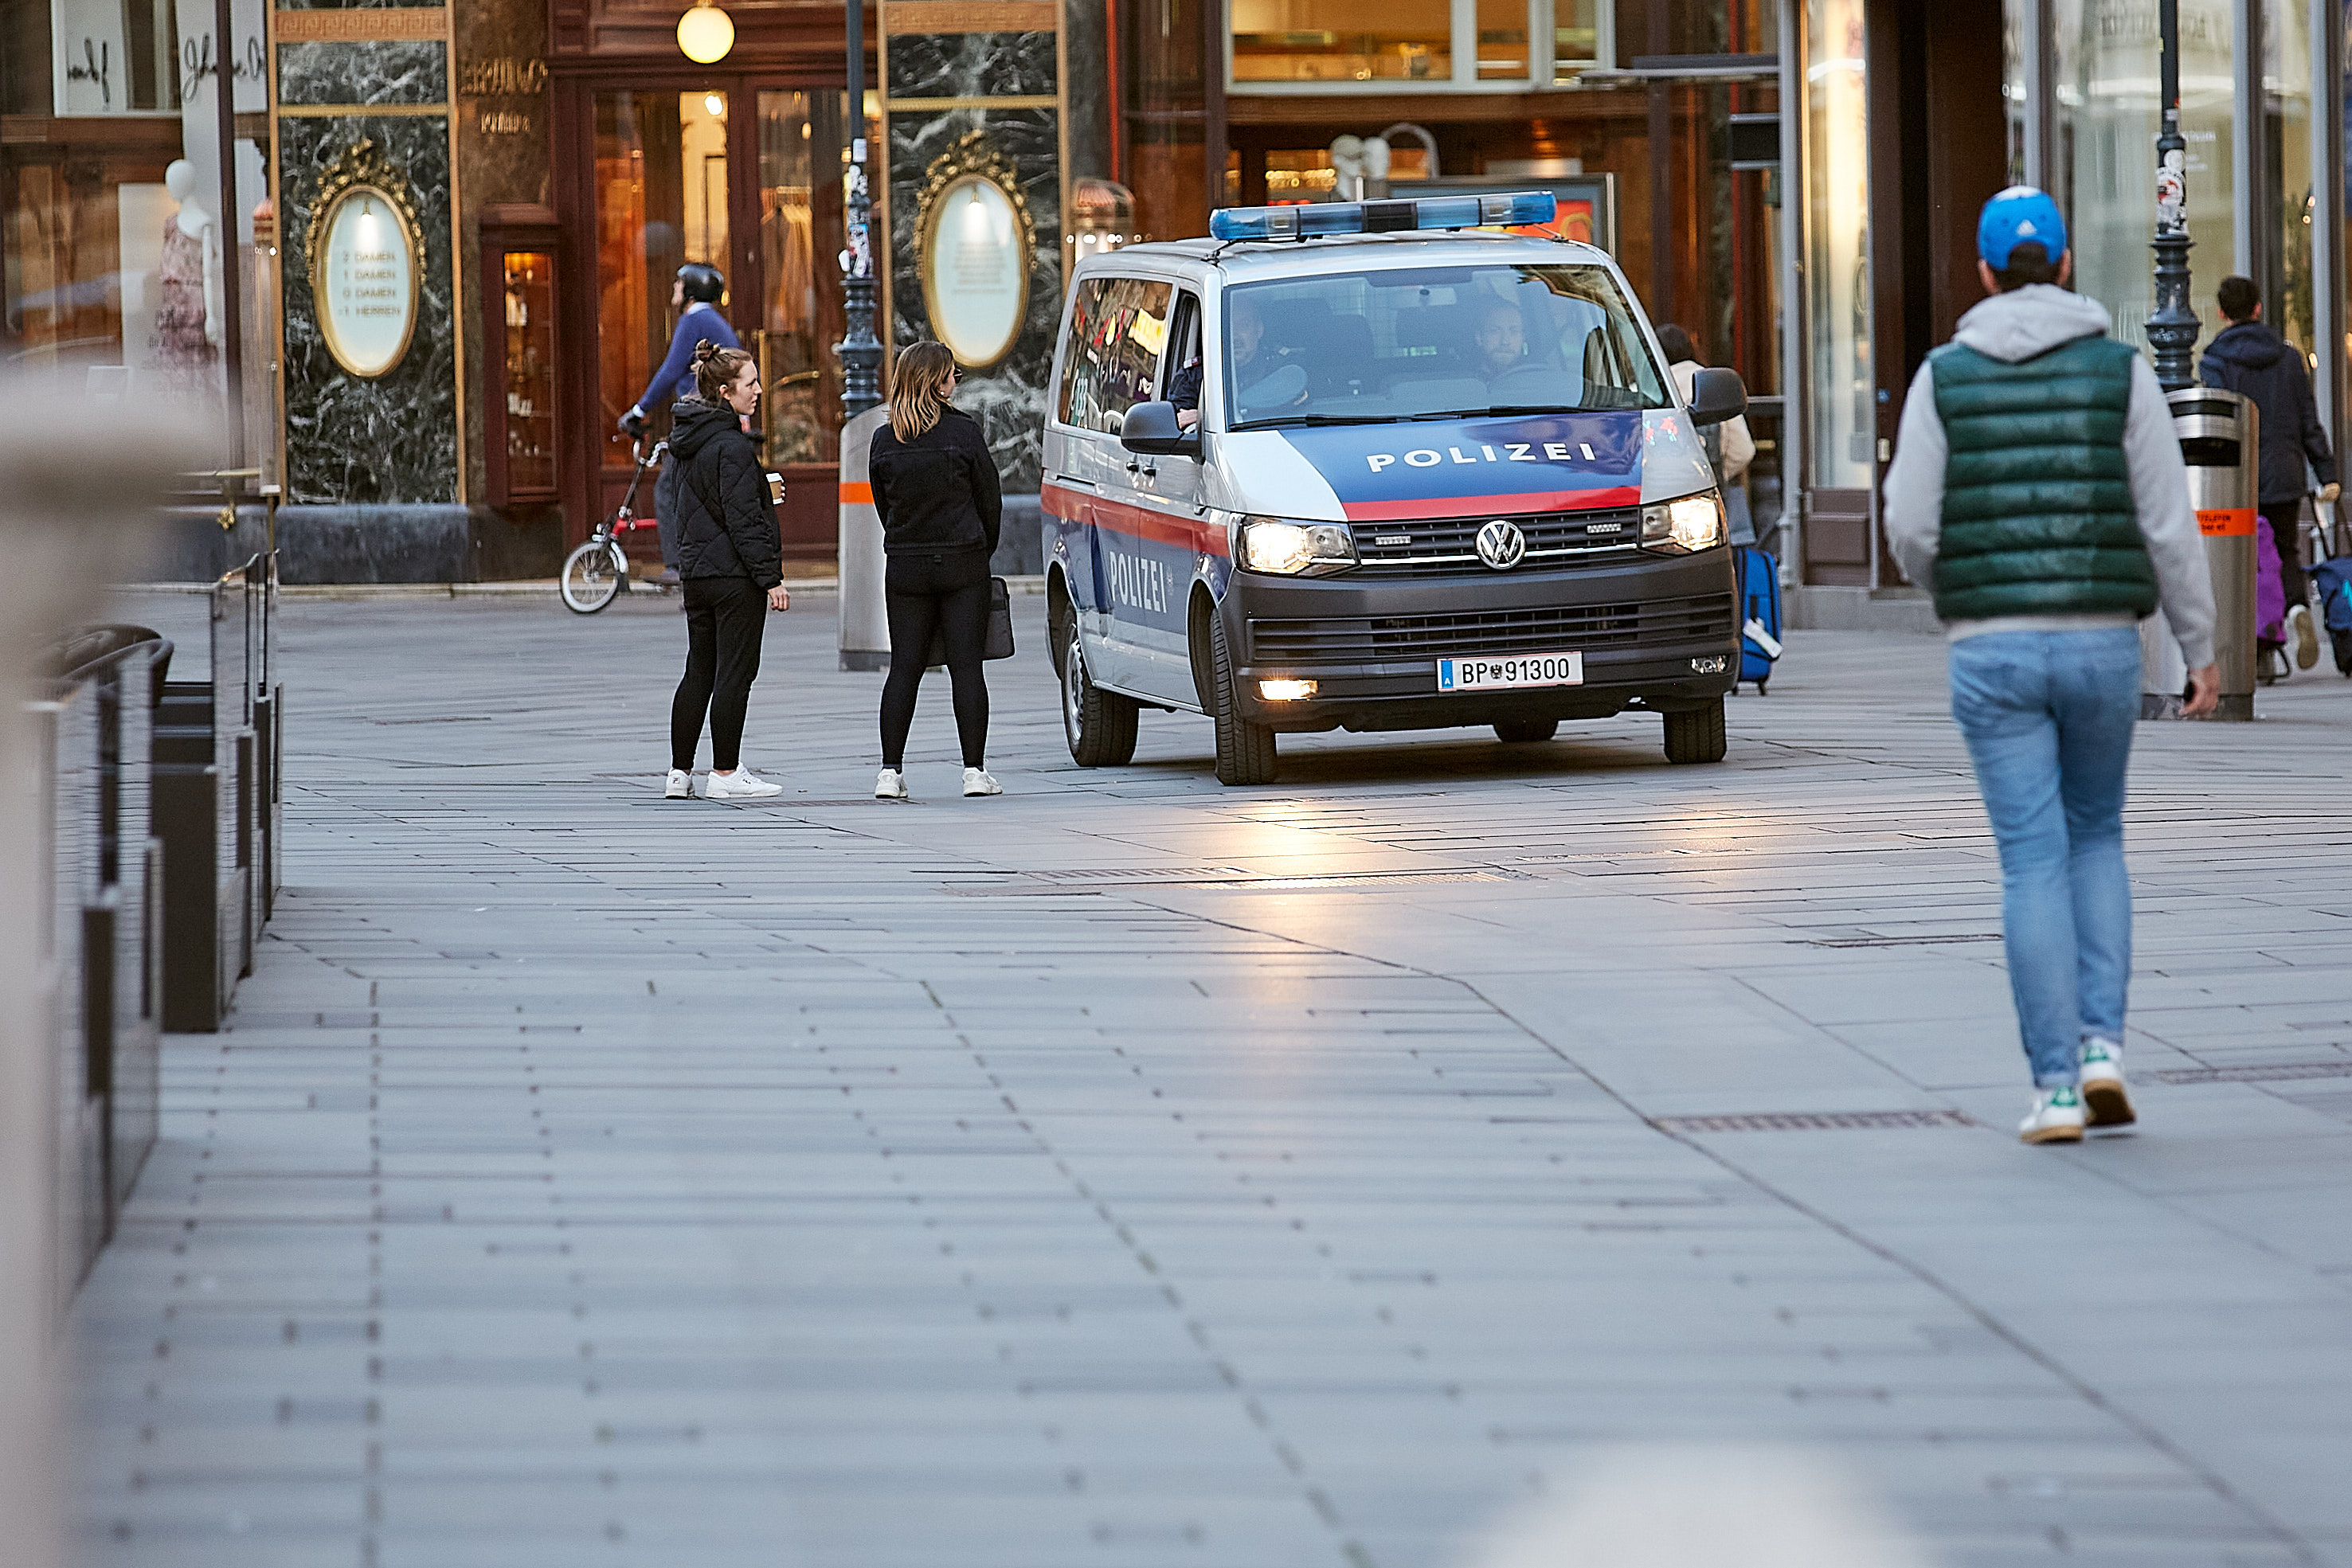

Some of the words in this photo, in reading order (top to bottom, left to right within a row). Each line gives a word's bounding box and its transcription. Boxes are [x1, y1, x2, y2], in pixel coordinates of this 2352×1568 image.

[354, 252, 396, 263] DAMEN
[354, 269, 396, 280] DAMEN
[354, 287, 396, 299] DAMEN
[355, 305, 401, 317] HERREN
[1366, 443, 1596, 473] POLIZEI
[1476, 520, 1525, 569] VW
[1109, 551, 1167, 614] POLIZEI
[1462, 662, 1488, 684] BP
[1505, 658, 1569, 681] 91300
